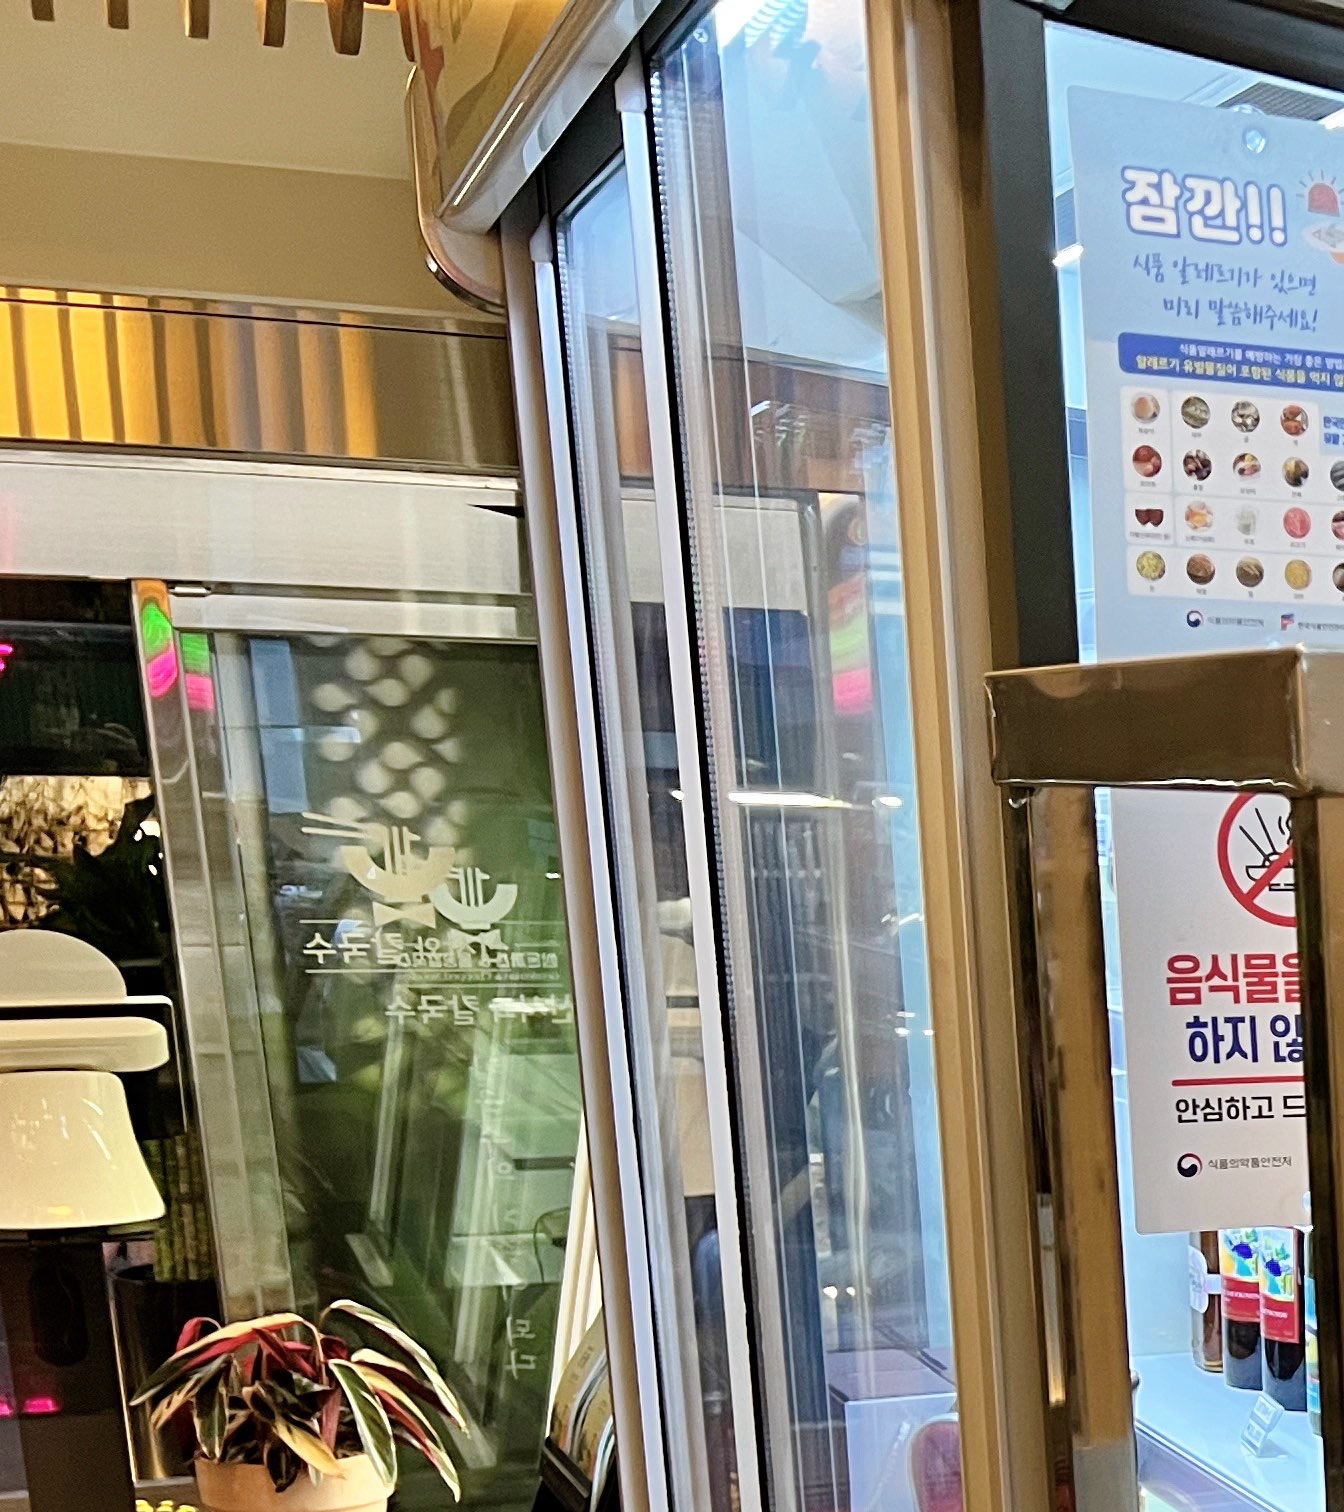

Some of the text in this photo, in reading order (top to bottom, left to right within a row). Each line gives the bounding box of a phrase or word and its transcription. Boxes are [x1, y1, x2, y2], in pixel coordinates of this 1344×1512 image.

[1121, 166, 1287, 246] 잠깐!!
[1134, 252, 1316, 296] 식품 알레르기가 있으면
[1164, 297, 1318, 332] 미리 말씀해주세요!
[1186, 1015, 1258, 1064] 하지
[1176, 1096, 1274, 1124] 안심하고
